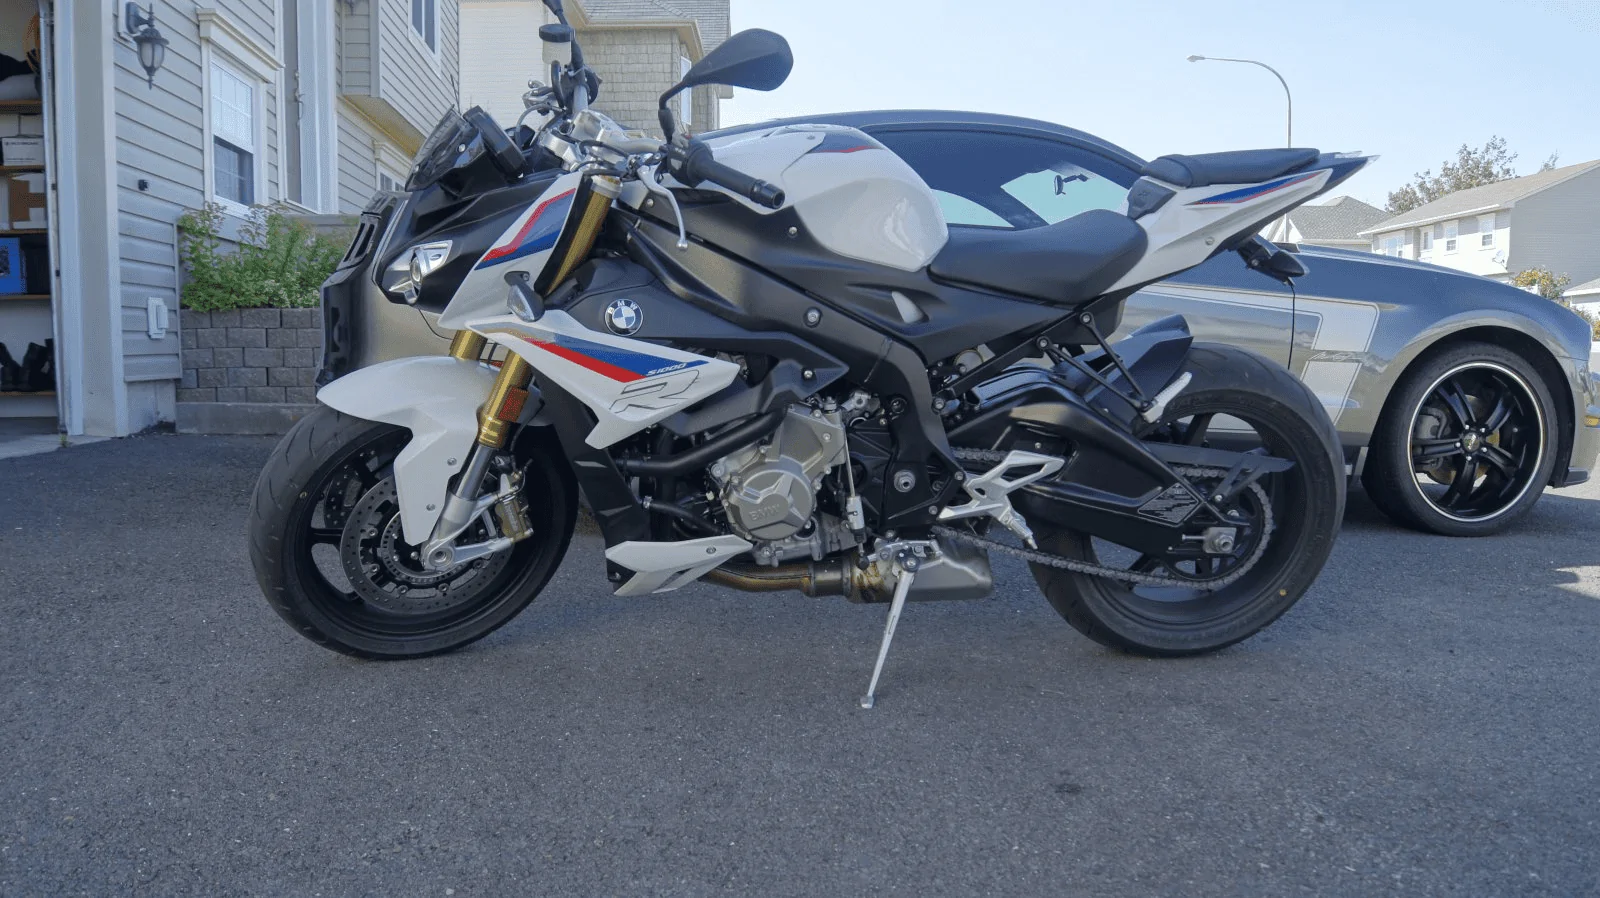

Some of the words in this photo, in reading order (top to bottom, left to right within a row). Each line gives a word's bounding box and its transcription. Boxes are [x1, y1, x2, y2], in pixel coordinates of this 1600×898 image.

[606, 300, 639, 315] BMW
[646, 362, 687, 377] S1000
[749, 503, 780, 520] BMW
